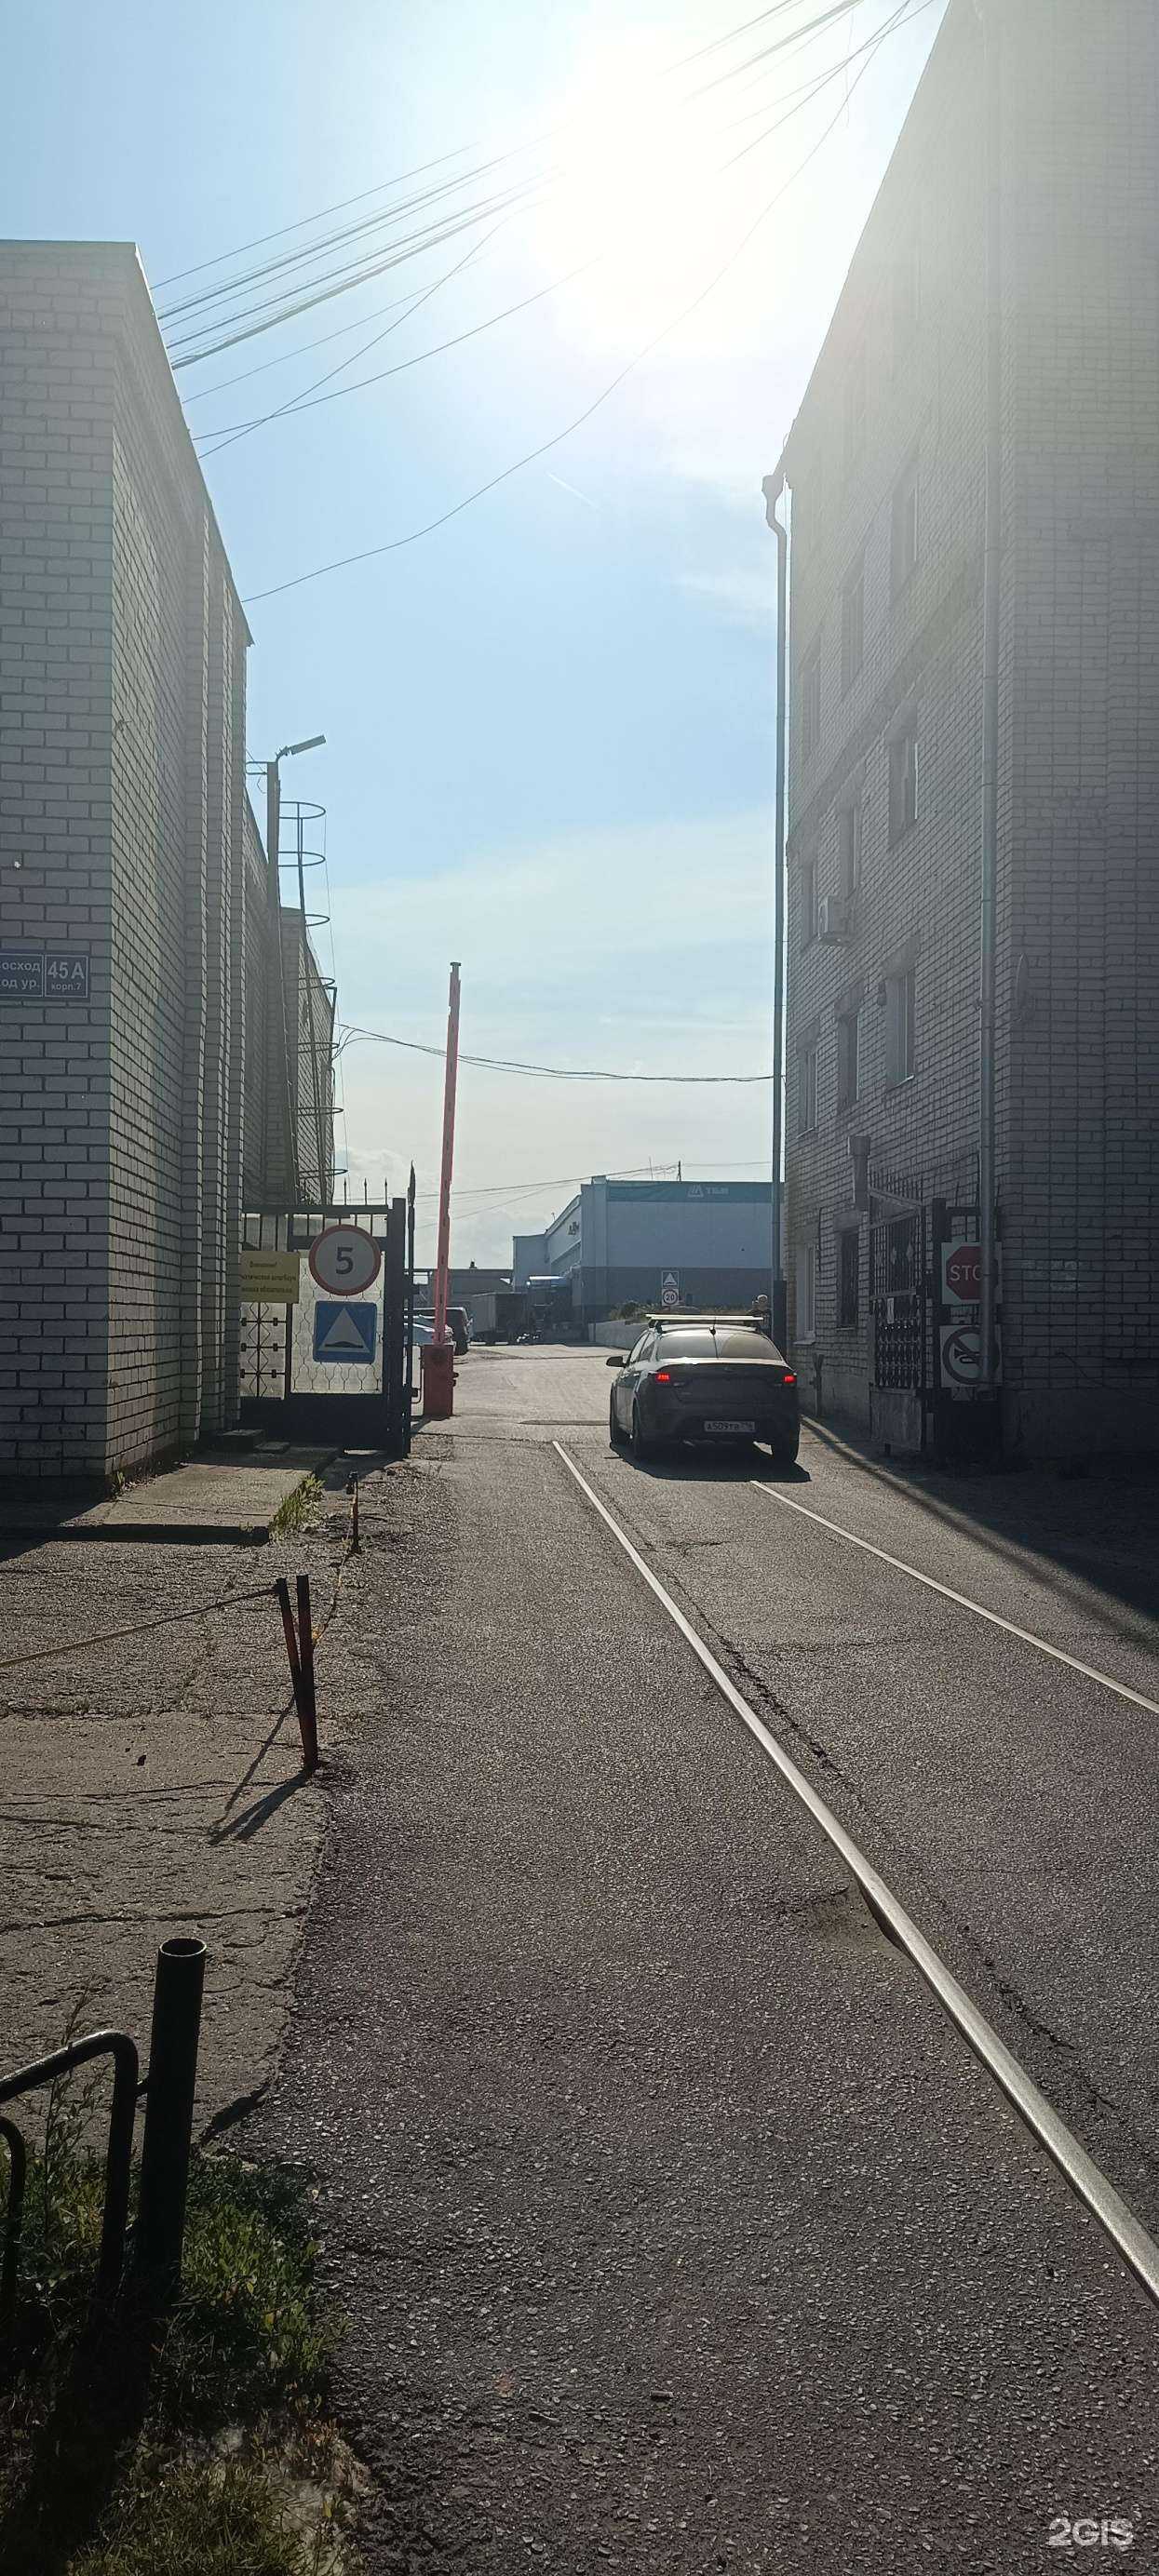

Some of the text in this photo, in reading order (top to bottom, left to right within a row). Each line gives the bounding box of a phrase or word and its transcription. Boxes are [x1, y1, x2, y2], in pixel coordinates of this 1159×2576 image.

[0, 961, 41, 973] осход
[0, 979, 18, 989] од
[335, 1246, 354, 1275] 5
[949, 1265, 984, 1281] STO
